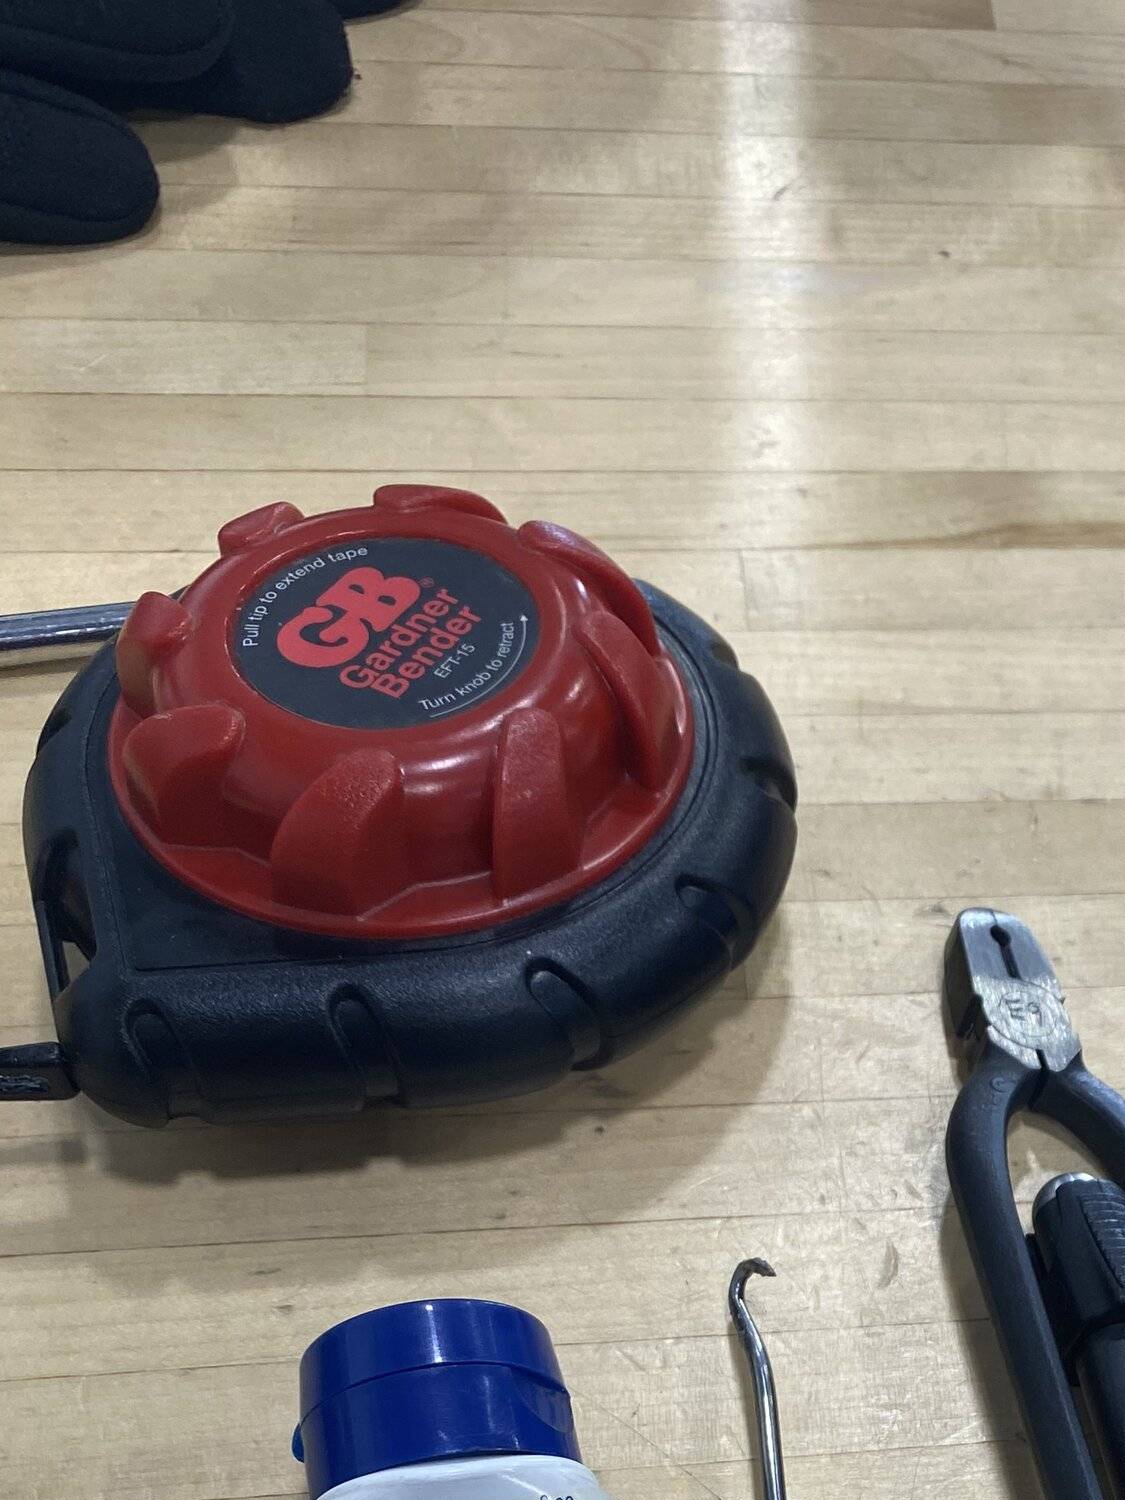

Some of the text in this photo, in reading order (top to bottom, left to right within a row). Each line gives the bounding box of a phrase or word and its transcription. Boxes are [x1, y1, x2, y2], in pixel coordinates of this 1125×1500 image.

[243, 547, 368, 647] Pull tip to extend tape
[276, 566, 421, 668] GB
[339, 588, 459, 689] Gardner
[370, 606, 482, 699] Bender
[418, 621, 515, 710] Turn knob to retract
[434, 643, 476, 679] EFT-15
